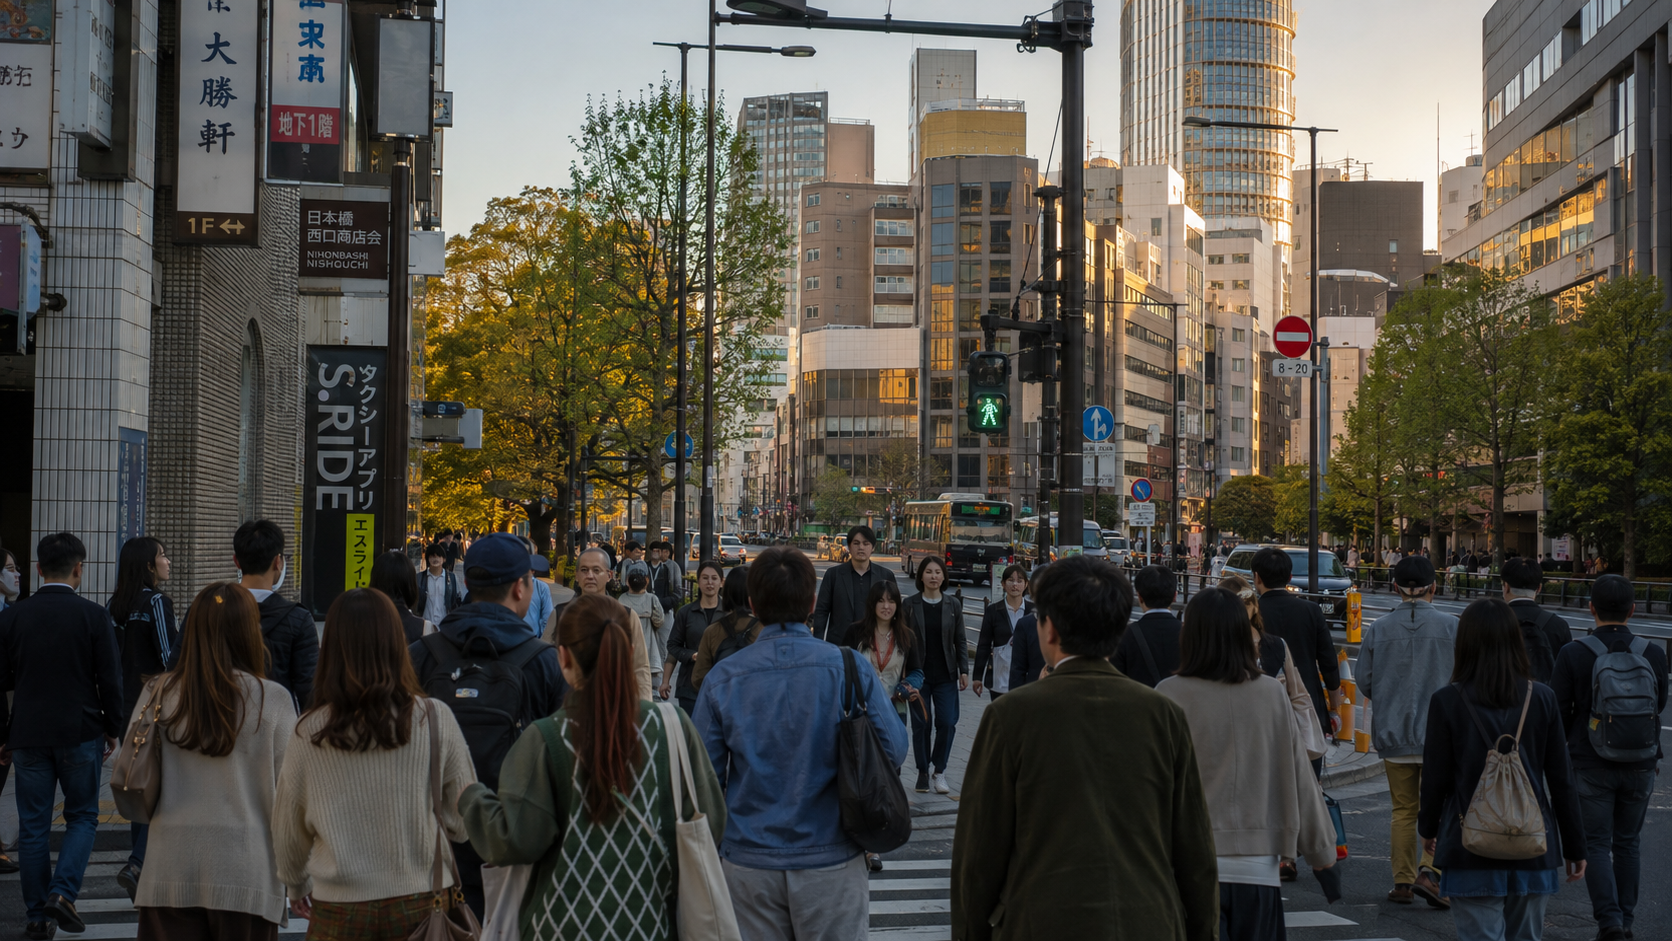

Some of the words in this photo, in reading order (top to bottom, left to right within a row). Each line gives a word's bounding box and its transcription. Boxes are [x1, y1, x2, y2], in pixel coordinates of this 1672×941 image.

[278, 111, 333, 138] 地下1階
[188, 217, 215, 234] 1F
[307, 210, 353, 226] 日本橋
[307, 228, 382, 245] 西口商店会
[306, 250, 369, 260] NIHONBASHI
[306, 260, 369, 269] NISHOUCHI
[315, 362, 356, 511] S.RIDE
[358, 364, 378, 511] タクシーアプリ
